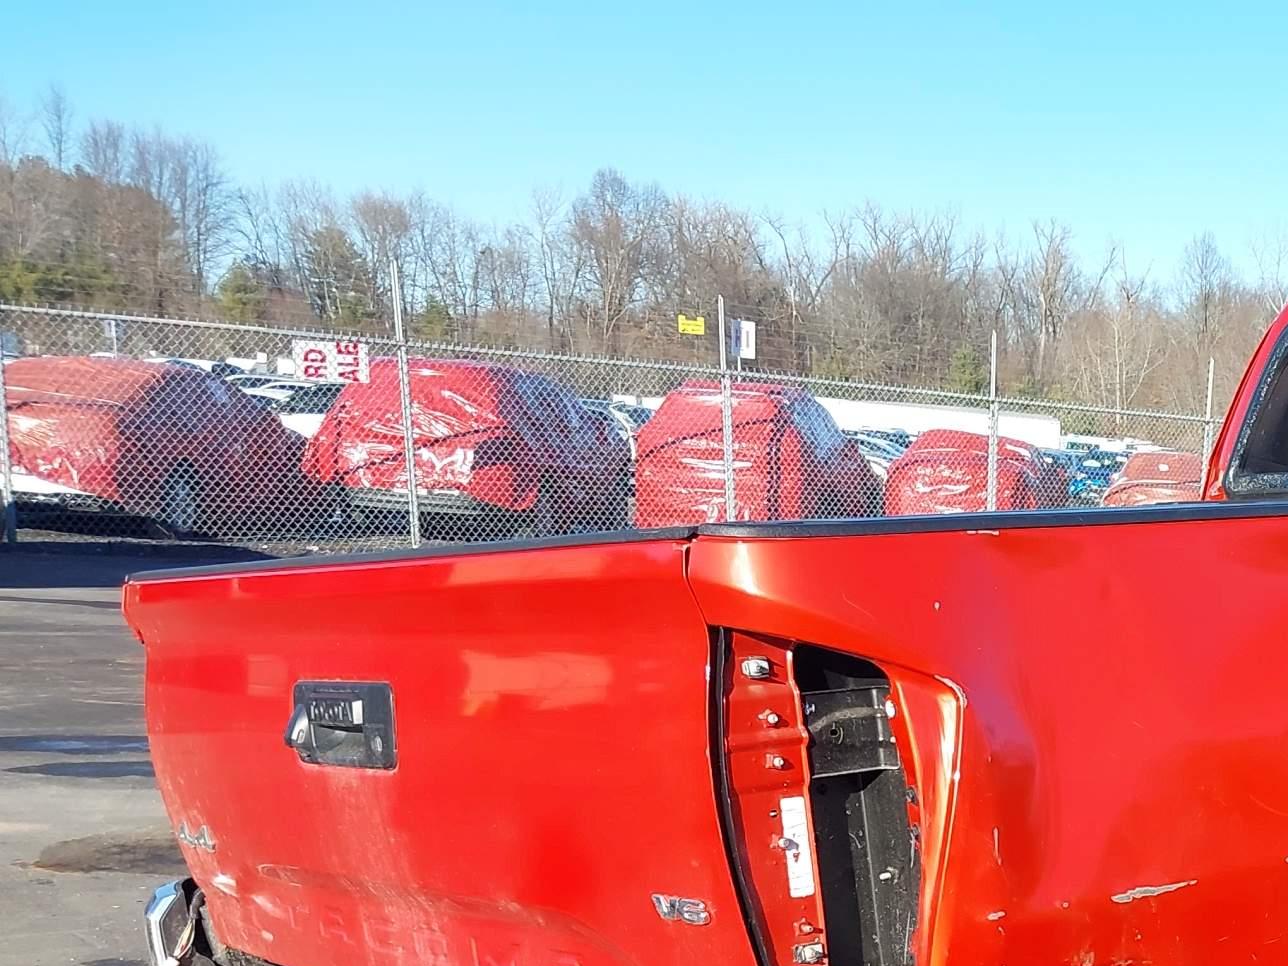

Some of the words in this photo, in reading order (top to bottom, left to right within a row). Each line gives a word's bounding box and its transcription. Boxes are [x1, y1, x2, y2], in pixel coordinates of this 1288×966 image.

[303, 348, 328, 378] RD
[335, 338, 361, 382] ALE
[650, 892, 712, 926] V6
